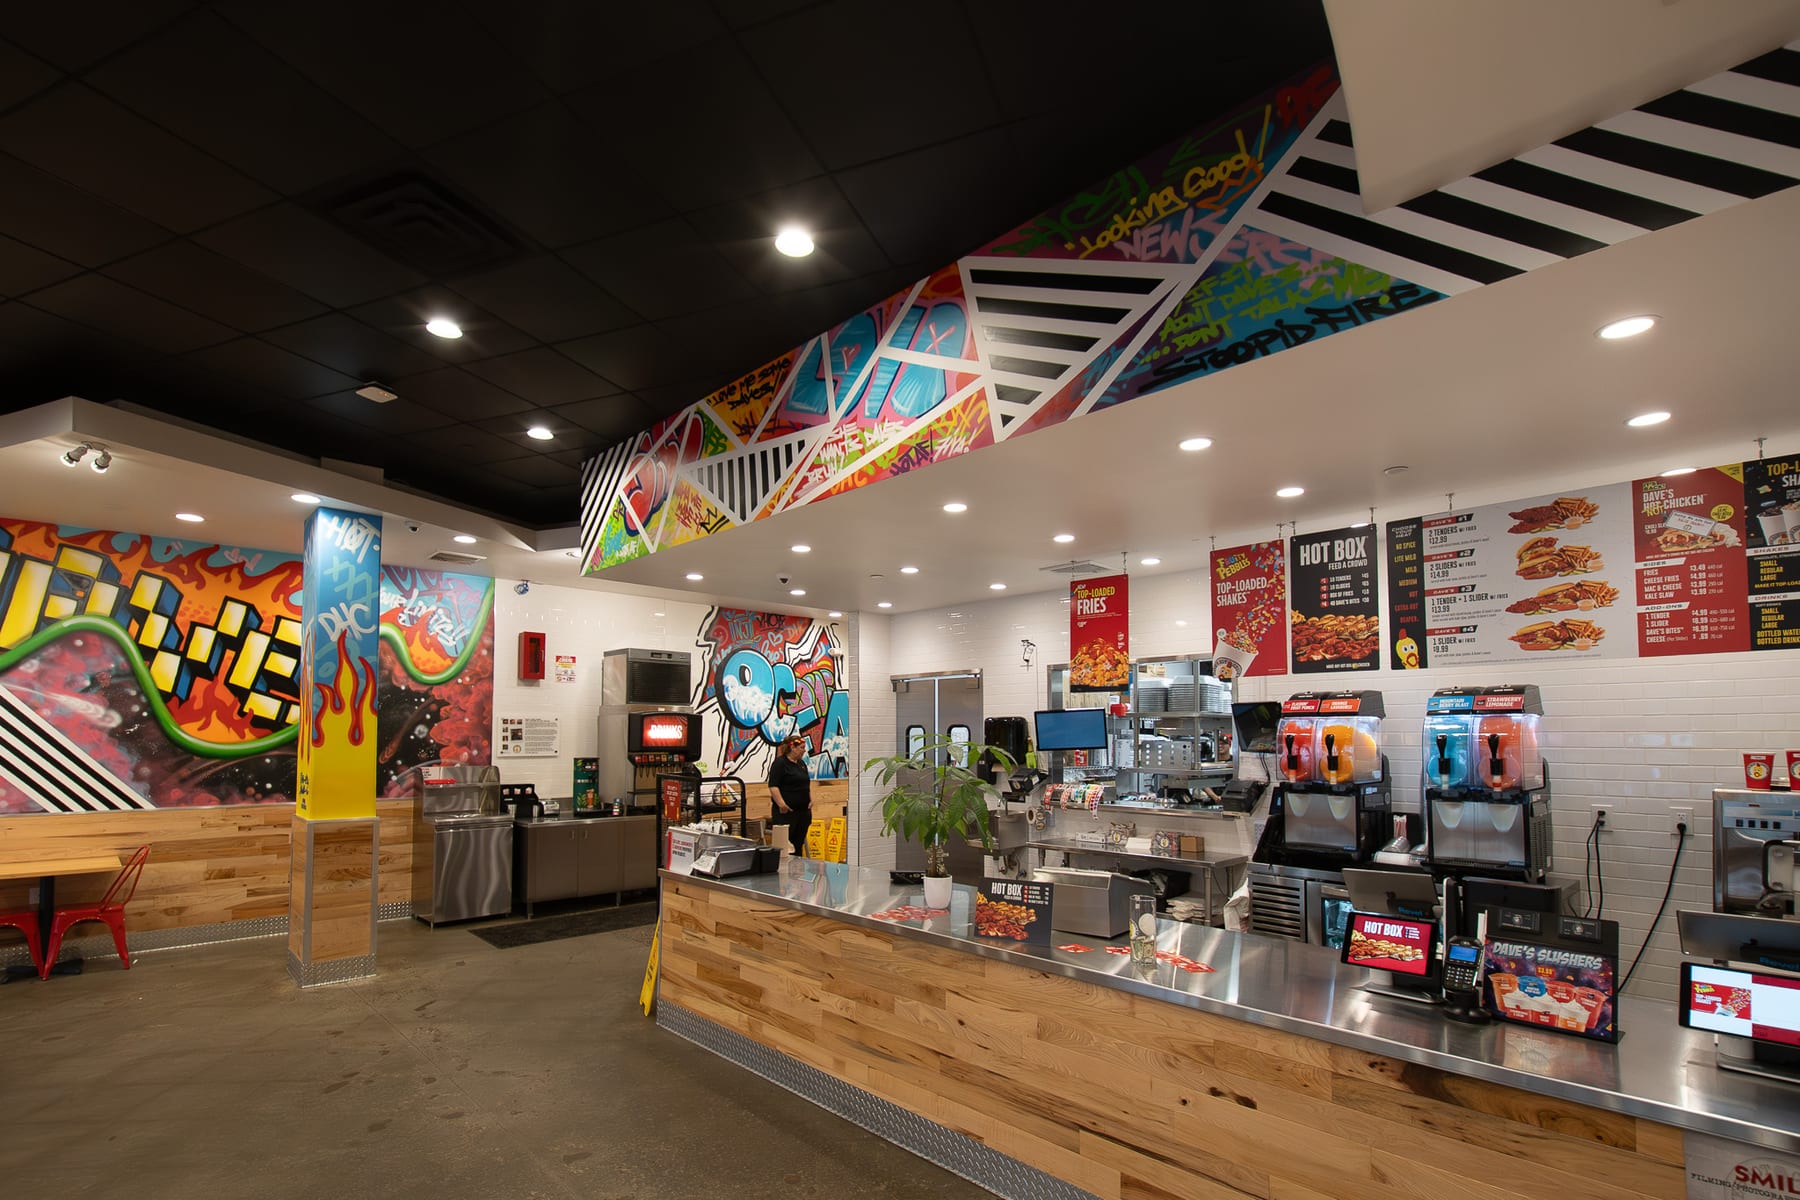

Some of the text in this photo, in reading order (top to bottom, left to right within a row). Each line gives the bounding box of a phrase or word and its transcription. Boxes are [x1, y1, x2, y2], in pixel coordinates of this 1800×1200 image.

[1183, 103, 1272, 200] Good!
[1113, 206, 1195, 261] NEW
[1138, 283, 1442, 393] STOOPID FIRE
[1643, 489, 1674, 502] DAVE'S
[1663, 494, 1704, 510] CHICKEN
[1458, 514, 1467, 522] #1
[1429, 529, 1433, 537] 2
[1434, 526, 1458, 537] TENDERS
[1403, 541, 1416, 549] SPICE
[1429, 536, 1448, 545] $12.99
[1299, 536, 1367, 567] HOT BOX
[1394, 553, 1416, 563] LITE MILD
[1216, 559, 1251, 580] PEBBLES
[1328, 558, 1368, 571] FEED A CROWD
[1435, 561, 1458, 571] SLIDERS
[1760, 566, 1784, 574] REGULAR
[1430, 570, 1449, 579] $14.99
[1216, 577, 1268, 594] TOP-LOADED
[1335, 582, 1351, 590] SLIDERS
[1398, 578, 1417, 586] MEDIUM
[1643, 577, 1663, 585] CHEESE
[1077, 586, 1115, 599] TOP-LOADED
[1409, 590, 1418, 598] HOT
[1659, 591, 1675, 599] SLAW
[1216, 592, 1248, 607] SHAKES
[1431, 598, 1435, 606] 1
[1436, 596, 1457, 605] TENDER
[1463, 595, 1467, 603] 1
[1468, 593, 1489, 602] SLIDER
[1077, 597, 1108, 615] FRIES
[1431, 605, 1450, 613] $13.99
[1650, 612, 1670, 620] TENDER
[318, 602, 377, 642] DHC
[1646, 628, 1665, 636] DAVE'S
[1437, 637, 1457, 646] SLIDER
[1757, 637, 1782, 645] BOTTLED
[1432, 645, 1449, 653] $9.99
[648, 724, 684, 740] DRINKS
[992, 882, 1006, 895] HOT
[1007, 883, 1023, 897] BOX
[1364, 920, 1384, 935] HOT
[1383, 923, 1403, 938] BOX
[1492, 941, 1603, 970] DAVE'S SLUSHERS
